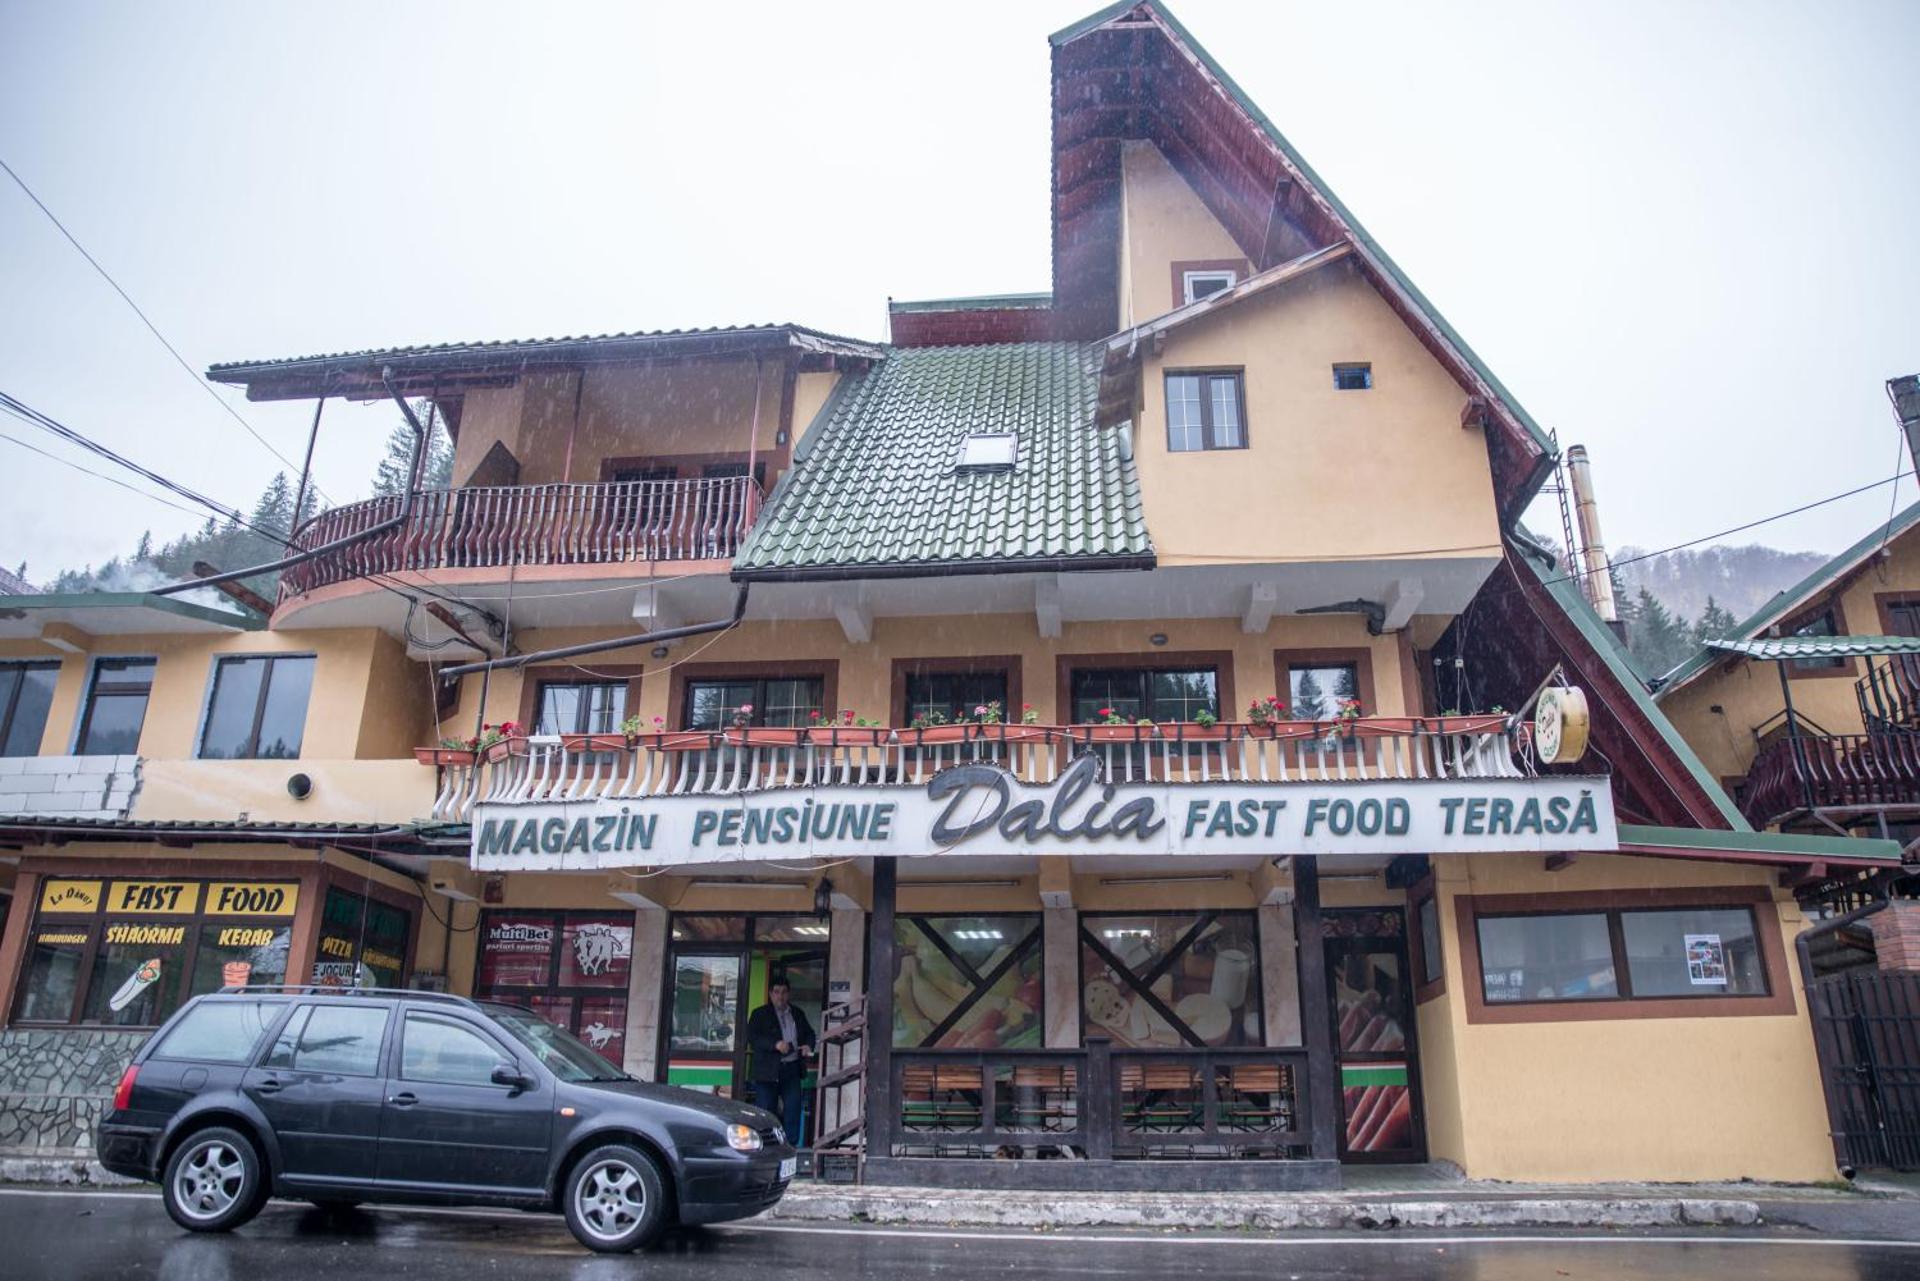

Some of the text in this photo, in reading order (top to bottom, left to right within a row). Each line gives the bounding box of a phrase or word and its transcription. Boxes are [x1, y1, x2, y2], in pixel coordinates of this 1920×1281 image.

[928, 754, 1167, 846] Dalia
[1183, 798, 1288, 841] FAST
[1303, 797, 1411, 838] FOOD
[1438, 788, 1600, 837] TERASĂ
[121, 885, 285, 912] FAST FOOD
[105, 926, 185, 944] SHAORMA
[218, 928, 274, 946] KEBAB
[322, 936, 353, 958] PIZZA
